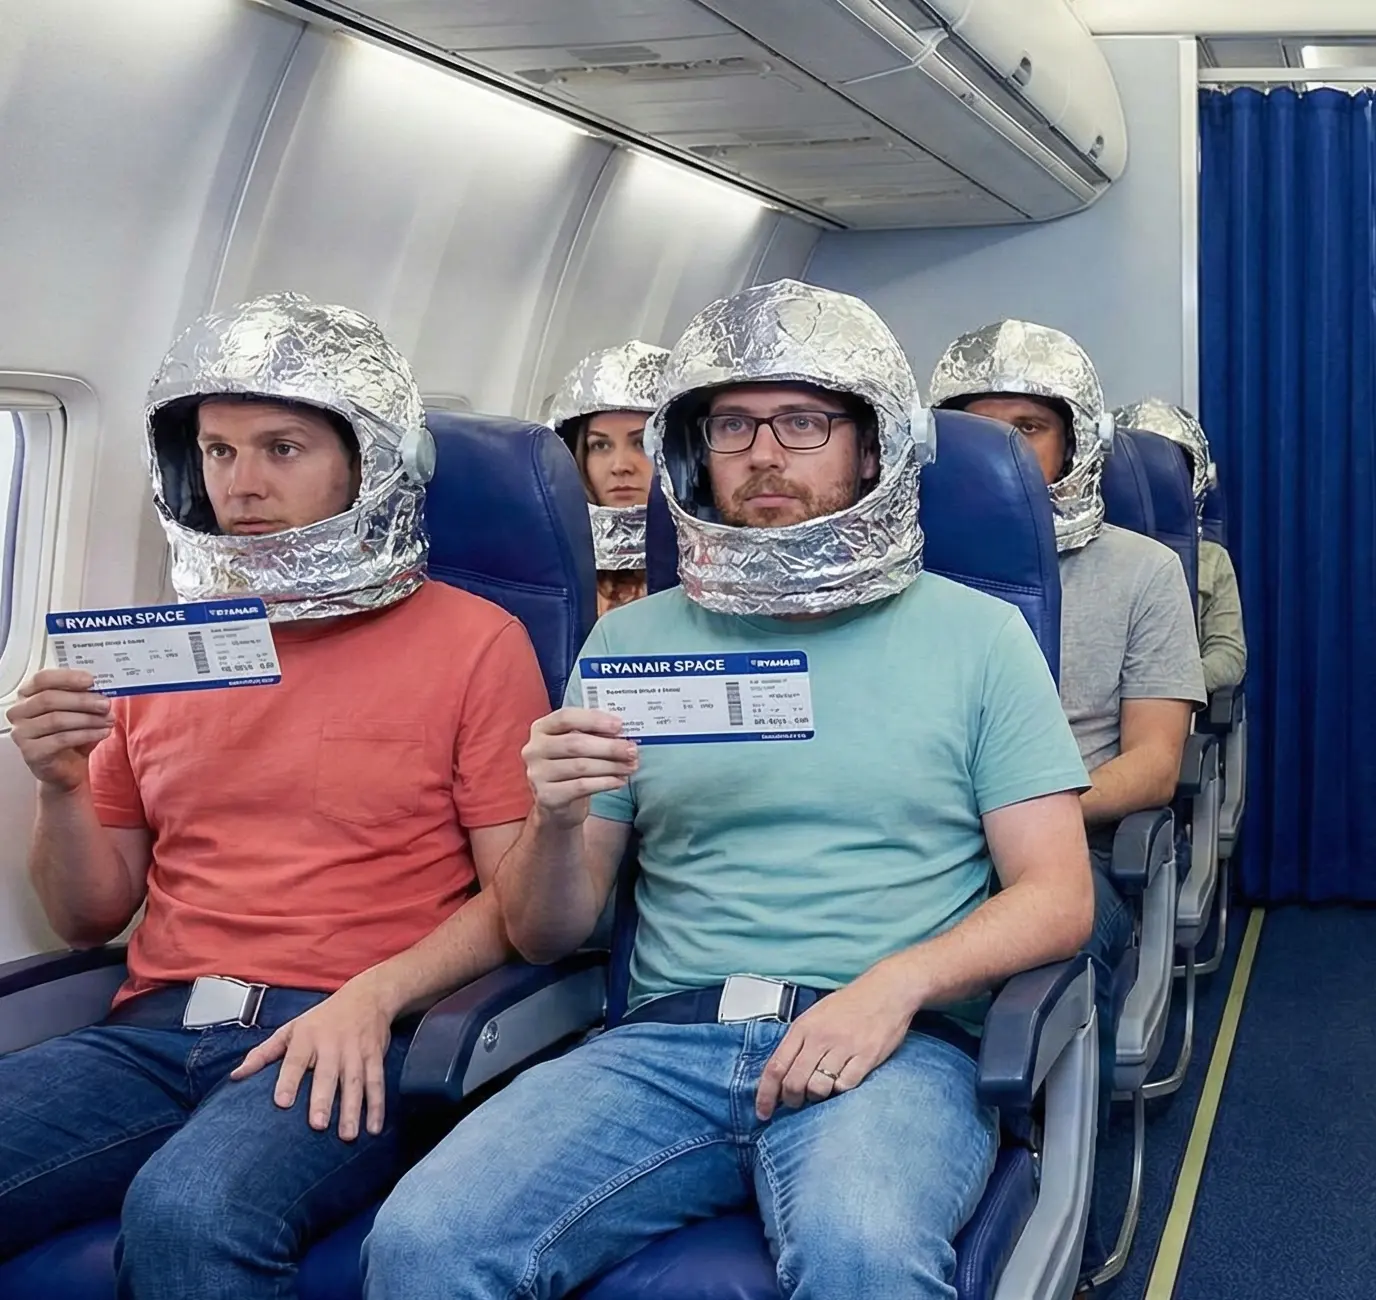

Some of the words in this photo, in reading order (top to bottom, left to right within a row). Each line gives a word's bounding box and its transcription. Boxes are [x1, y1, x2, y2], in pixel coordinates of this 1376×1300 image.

[65, 614, 133, 630] RYANAIR
[135, 610, 186, 625] SPACE
[601, 660, 671, 675] RYANAIR
[674, 659, 725, 672] SPACE
